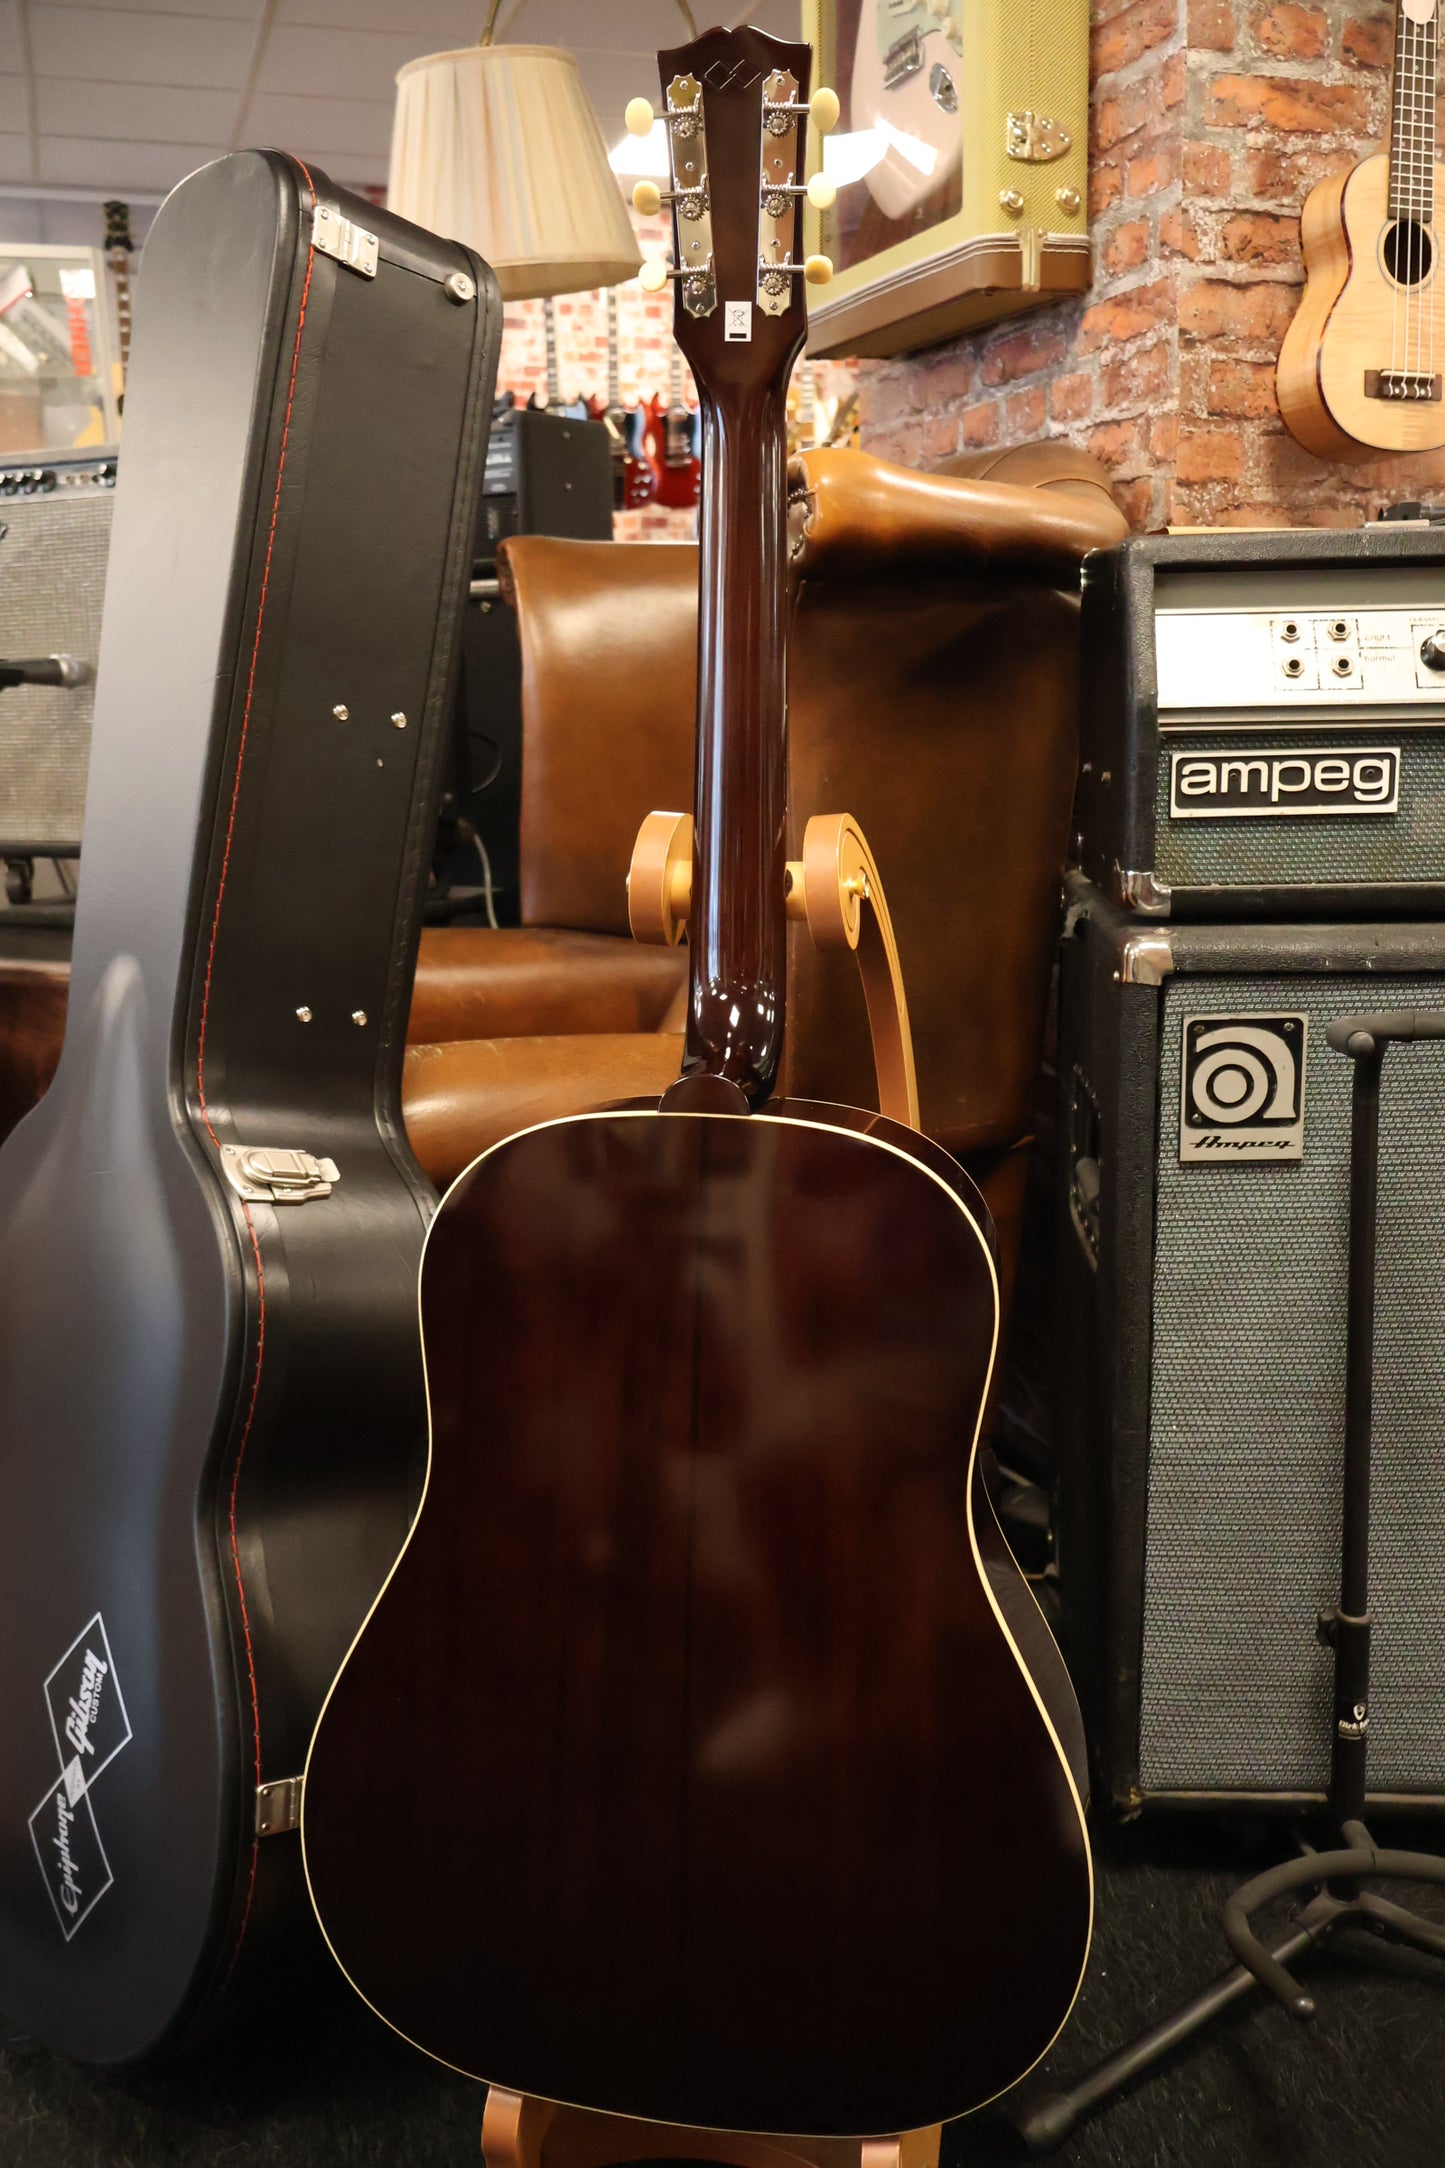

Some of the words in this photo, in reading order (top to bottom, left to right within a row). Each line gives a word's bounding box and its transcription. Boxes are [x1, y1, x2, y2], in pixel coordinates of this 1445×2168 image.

[1180, 758, 1390, 802] ampeg
[1190, 1135, 1295, 1150] Ampeg
[65, 1648, 108, 1756] Gibson
[90, 1672, 104, 1724] CUSTOM
[52, 1793, 82, 1917] Epiphone
